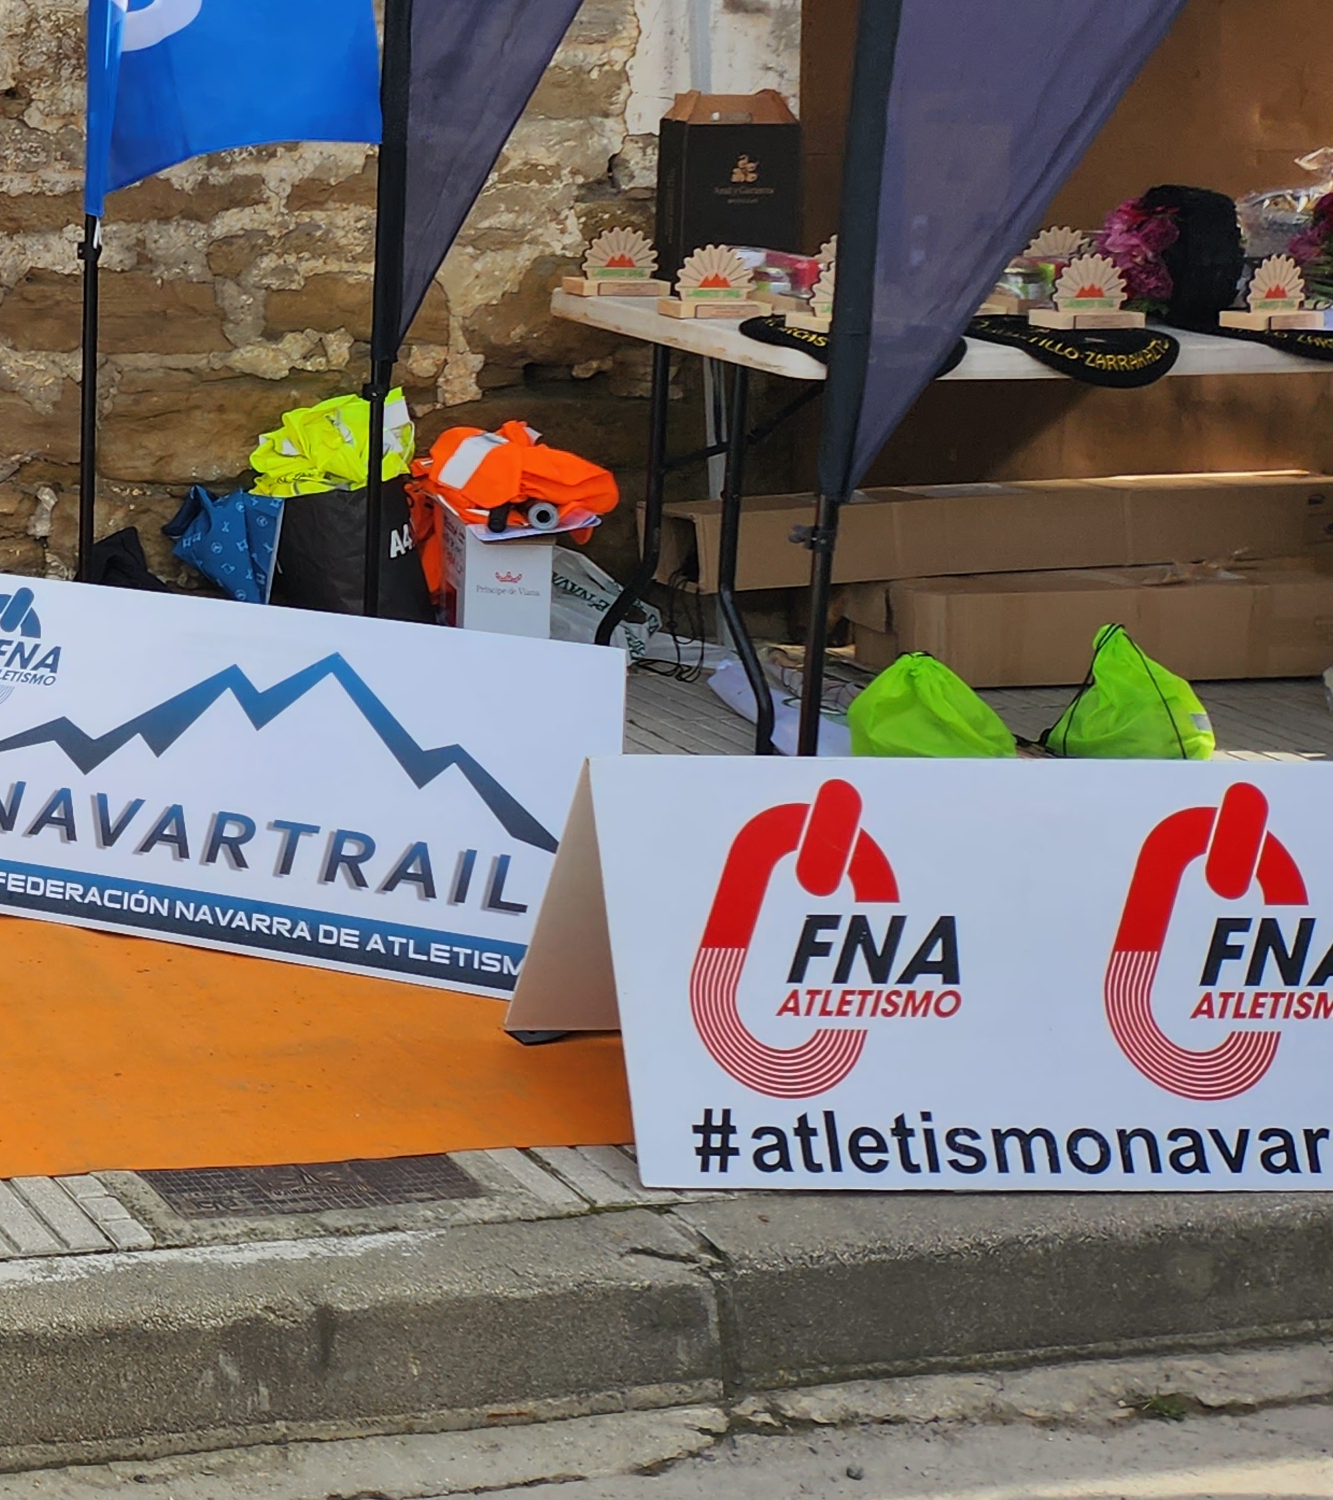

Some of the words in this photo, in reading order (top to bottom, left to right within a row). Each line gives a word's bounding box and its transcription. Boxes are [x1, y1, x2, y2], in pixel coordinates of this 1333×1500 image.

[174, 900, 313, 942] NAVARRA
[318, 923, 361, 951] DE
[365, 933, 522, 977] ATLETISM
[785, 914, 962, 985] FNA
[775, 988, 963, 1019] ATLETISMO
